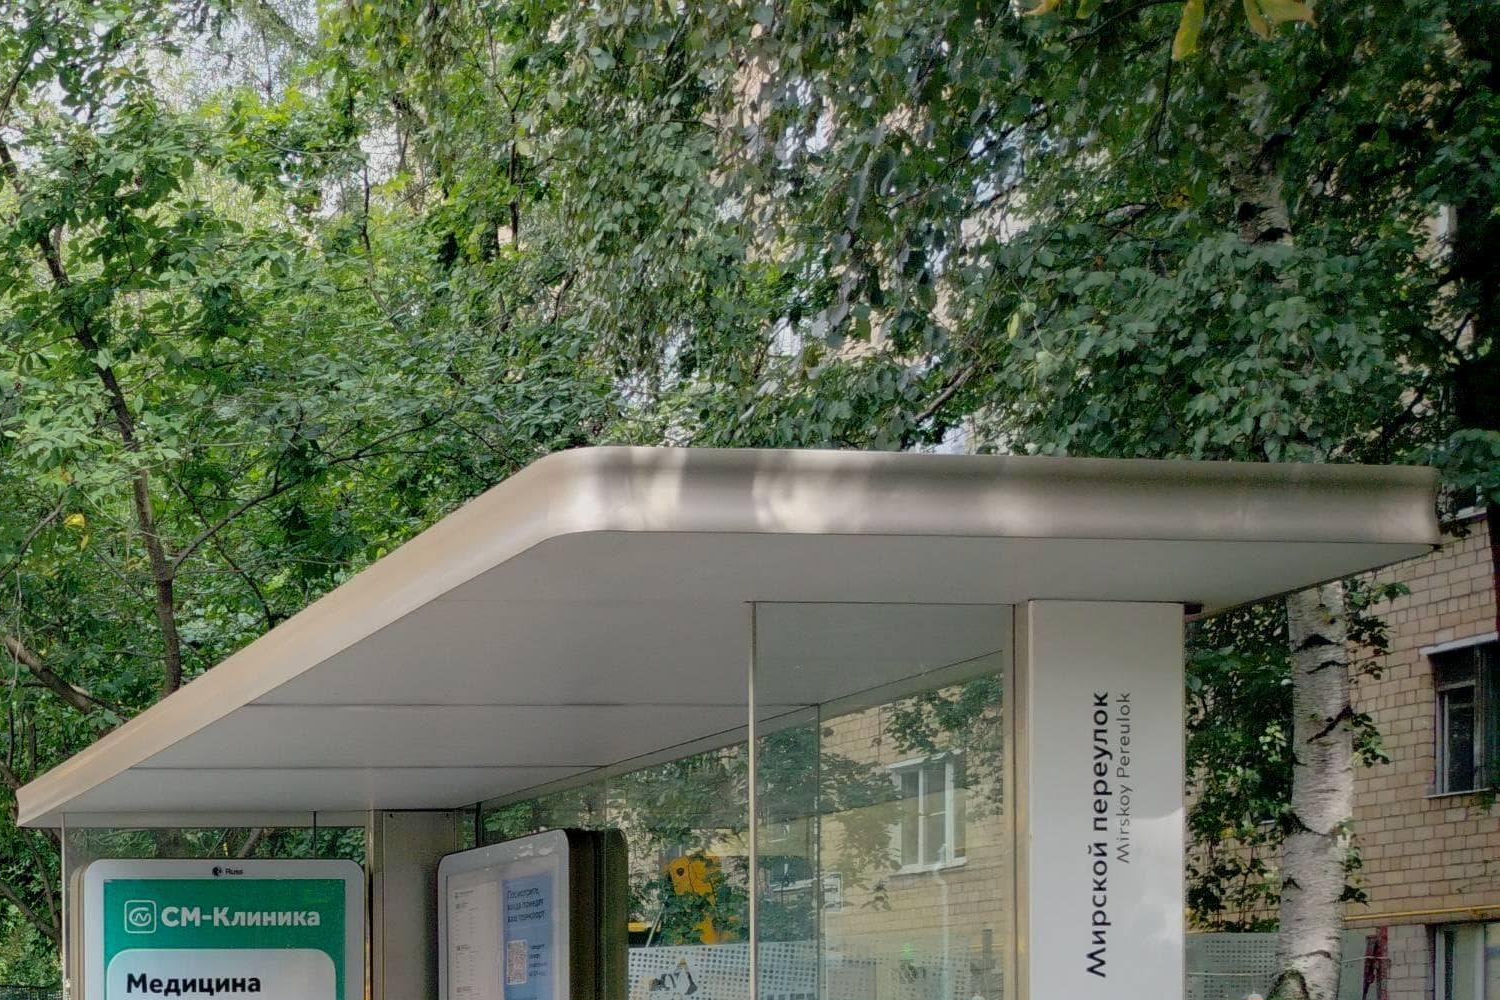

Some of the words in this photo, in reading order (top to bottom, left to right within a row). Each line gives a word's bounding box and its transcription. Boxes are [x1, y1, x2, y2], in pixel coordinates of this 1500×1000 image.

[1093, 692, 1113, 831] переулок
[1116, 692, 1130, 778] Pereulok
[1116, 785, 1133, 864] Mirskoy
[225, 868, 243, 876] Russ
[1086, 842, 1111, 978] Мирской
[160, 906, 321, 927] СМ-Клиника
[126, 973, 261, 996] Медицина
